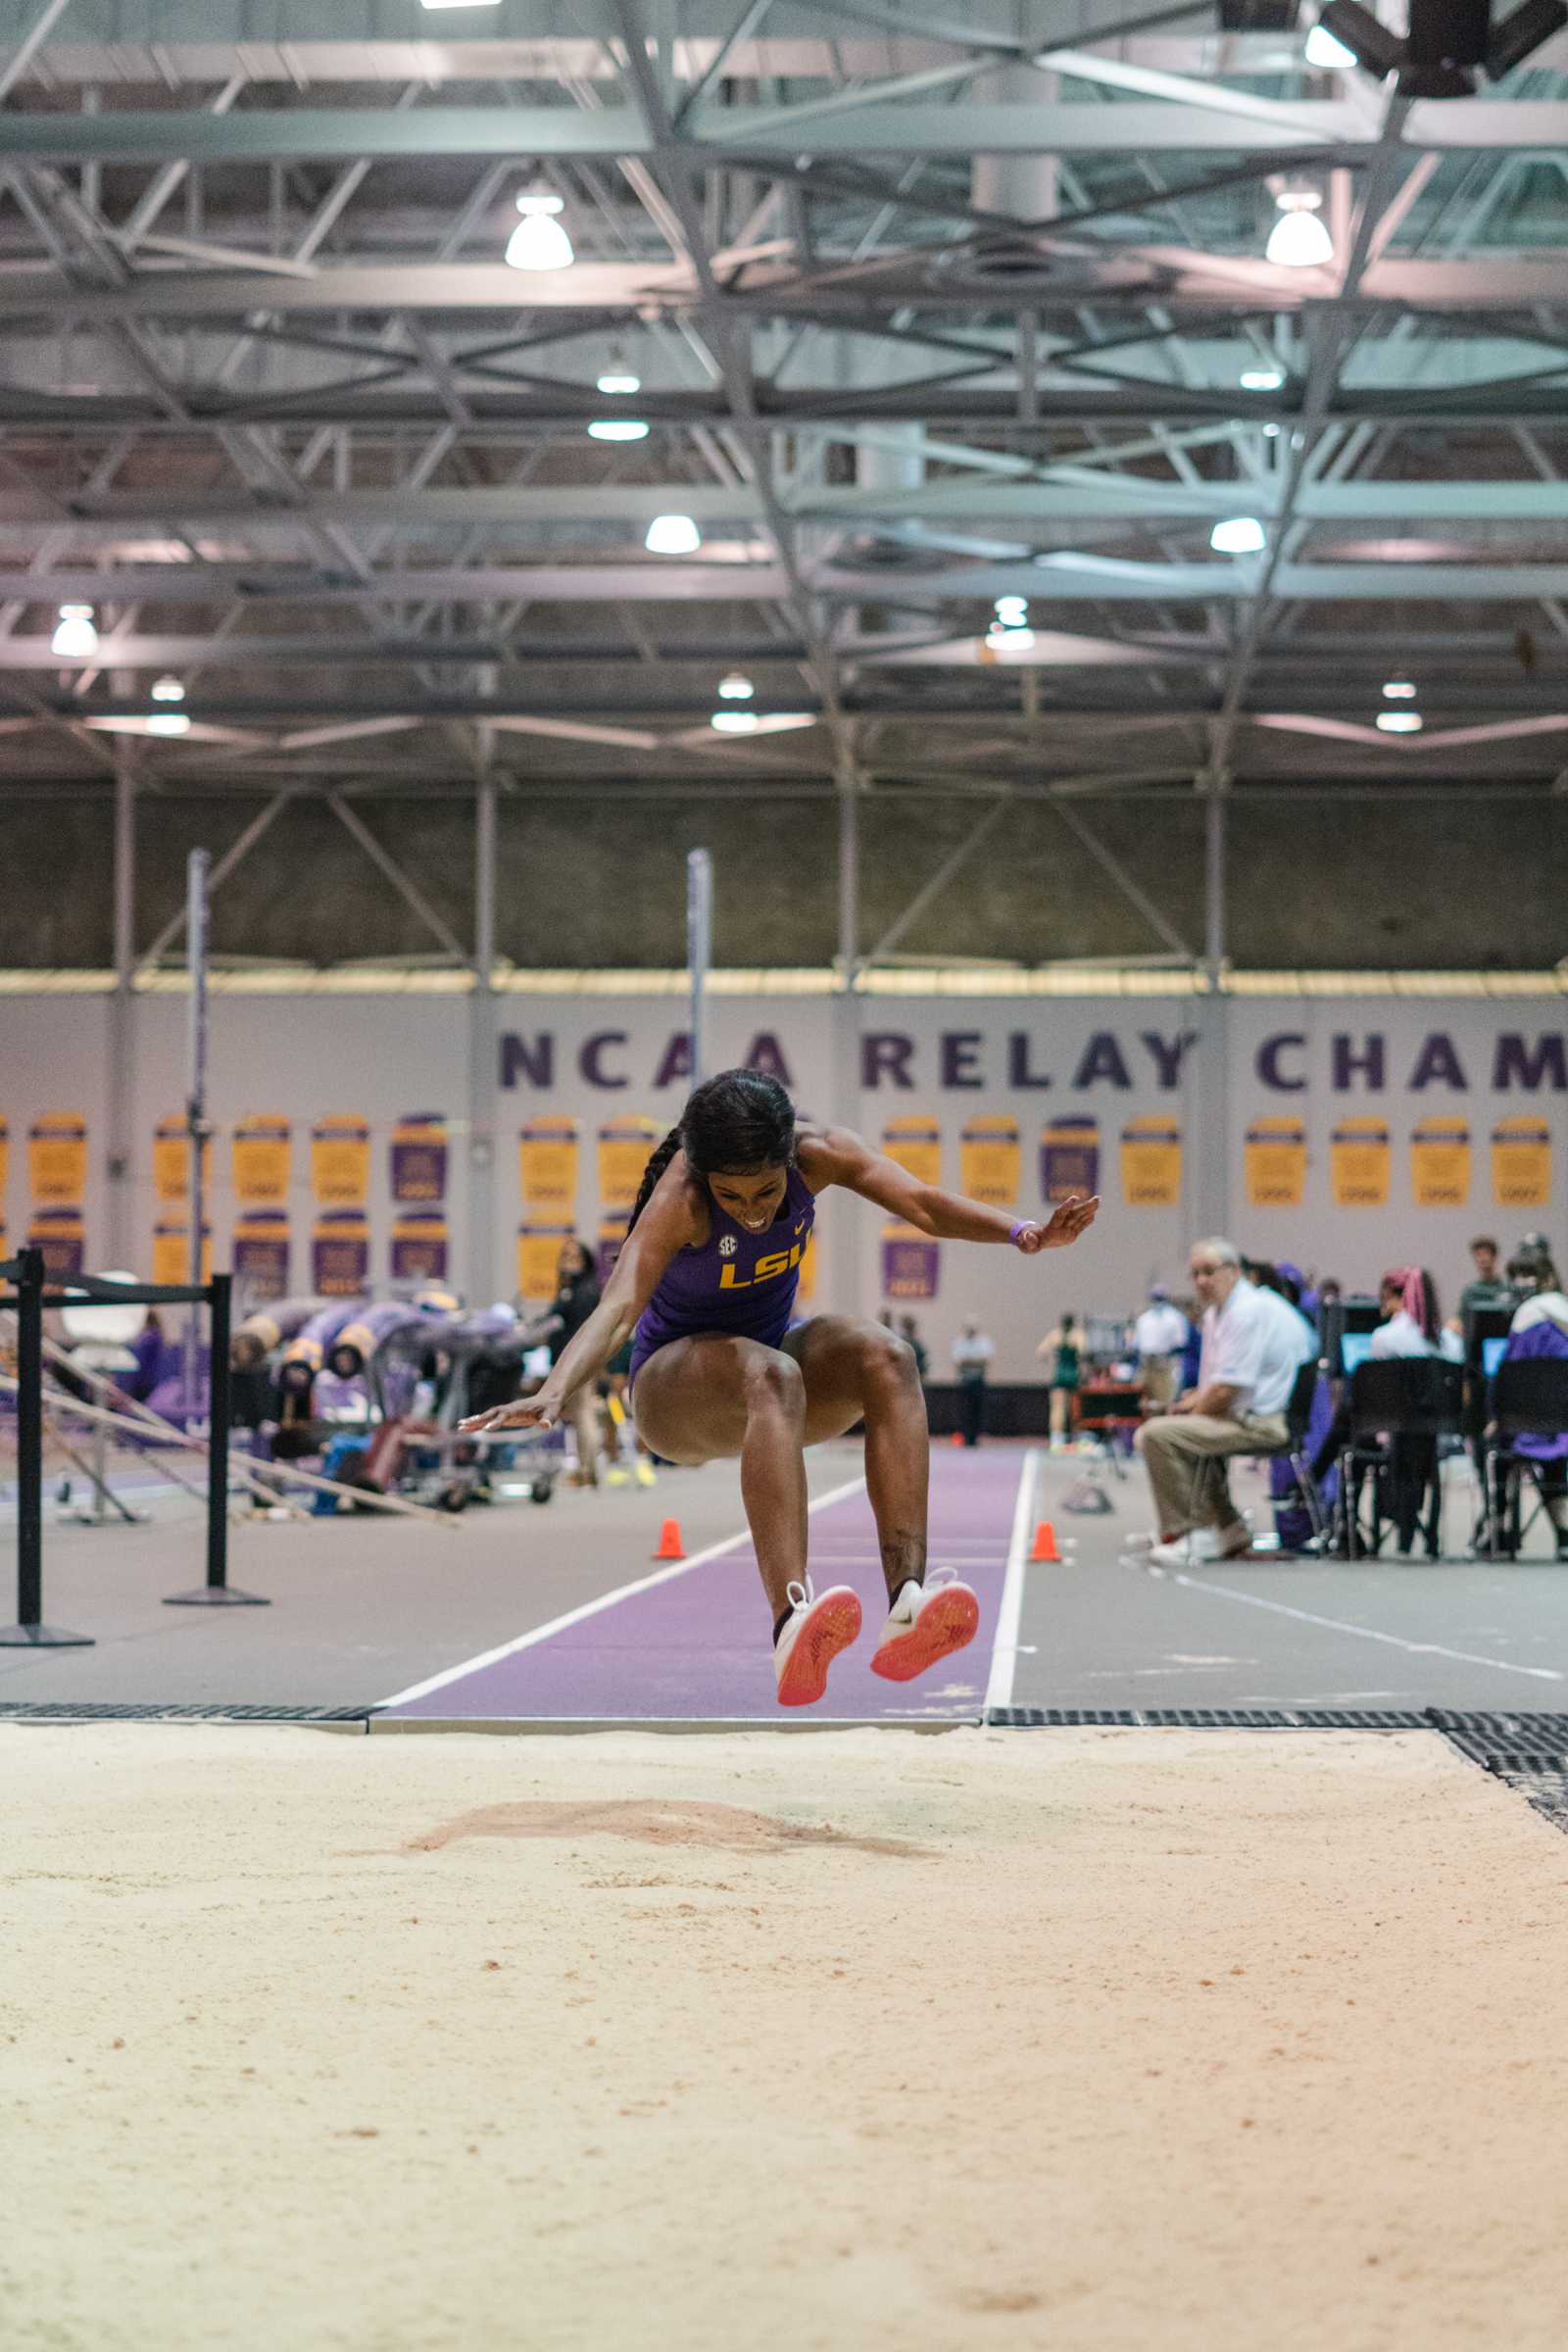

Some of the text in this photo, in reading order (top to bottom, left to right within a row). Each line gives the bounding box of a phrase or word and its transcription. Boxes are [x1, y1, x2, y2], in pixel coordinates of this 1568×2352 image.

[499, 1033, 1568, 1092] NCAA RELAY CHAM
[719, 1236, 737, 1255] SEC
